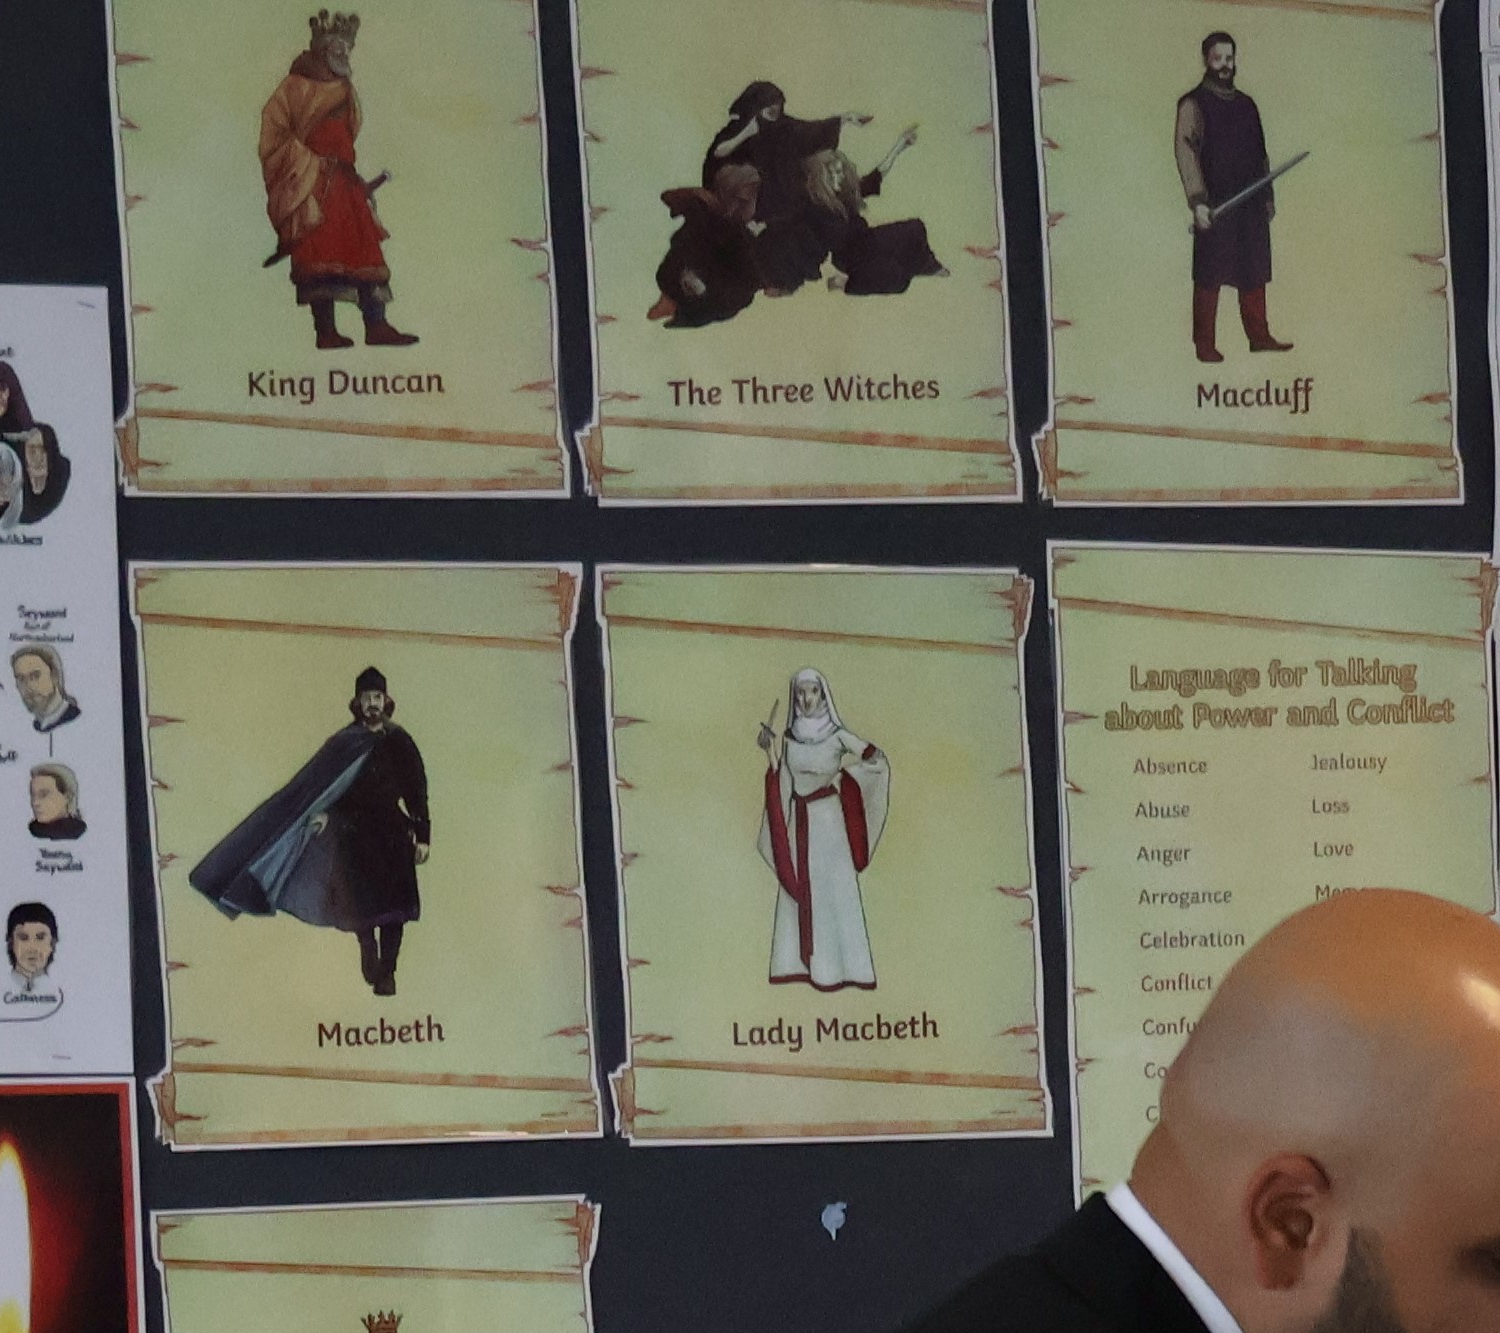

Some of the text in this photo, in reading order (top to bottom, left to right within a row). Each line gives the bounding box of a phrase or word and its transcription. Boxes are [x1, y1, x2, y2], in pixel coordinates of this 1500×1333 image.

[246, 368, 446, 408] King Duncan
[667, 372, 941, 408] The Three Witches
[1195, 376, 1314, 413] Macduff
[1130, 657, 1419, 697] Language for Talking
[1104, 694, 1456, 731] about Power and Conflict
[1133, 759, 1208, 775] Absence
[1310, 754, 1388, 773] Jealousy
[1135, 802, 1191, 819] Abuse
[1311, 799, 1350, 814] Loss
[1136, 846, 1192, 866] Anger
[1313, 841, 1355, 858] Love
[1138, 888, 1233, 909] Arrogance
[1140, 930, 1246, 950] Celebration
[1141, 974, 1213, 993] Conflict
[317, 1014, 447, 1048] Macbeth
[731, 1012, 940, 1053] Lady Macbeth
